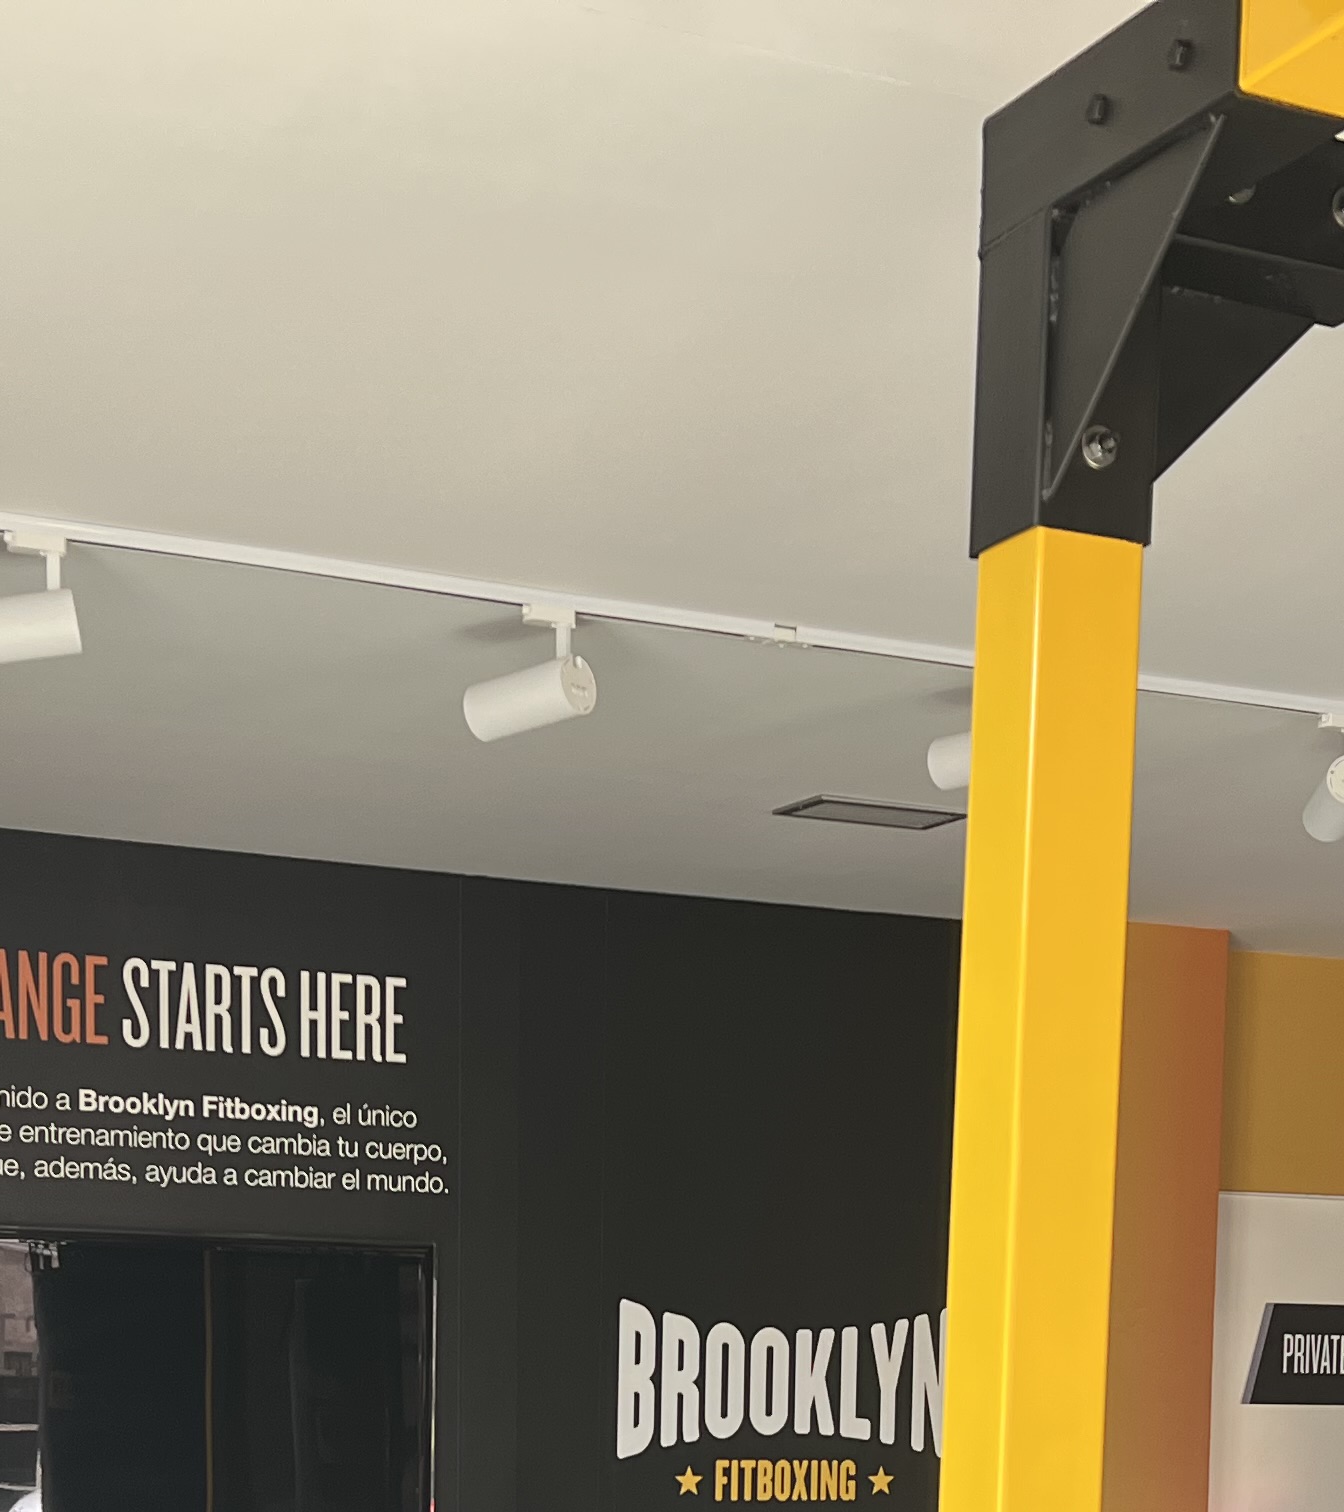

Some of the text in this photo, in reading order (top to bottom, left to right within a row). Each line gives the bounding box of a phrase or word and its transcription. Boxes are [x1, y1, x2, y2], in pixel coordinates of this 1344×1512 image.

[123, 958, 286, 1056] STARTS
[301, 971, 406, 1063] HERE
[56, 1093, 71, 1110] a
[79, 1089, 194, 1120] Brooklyn
[203, 1096, 324, 1128] Fitboxing,
[333, 1103, 350, 1124] el
[359, 1103, 417, 1128] único
[19, 1123, 190, 1150] entrenamiento
[197, 1134, 241, 1156] que
[248, 1133, 331, 1156] cambia
[337, 1136, 358, 1157] tu
[366, 1142, 446, 1165] cuerpo,
[34, 1156, 136, 1184] además,
[145, 1162, 217, 1187] ayuda
[223, 1168, 238, 1185] a
[245, 1166, 336, 1189] cambiar
[342, 1169, 359, 1190] el
[367, 1171, 448, 1193] mundo.
[617, 1298, 947, 1459] BROOKLYN
[714, 1459, 856, 1502] FITBOXING
